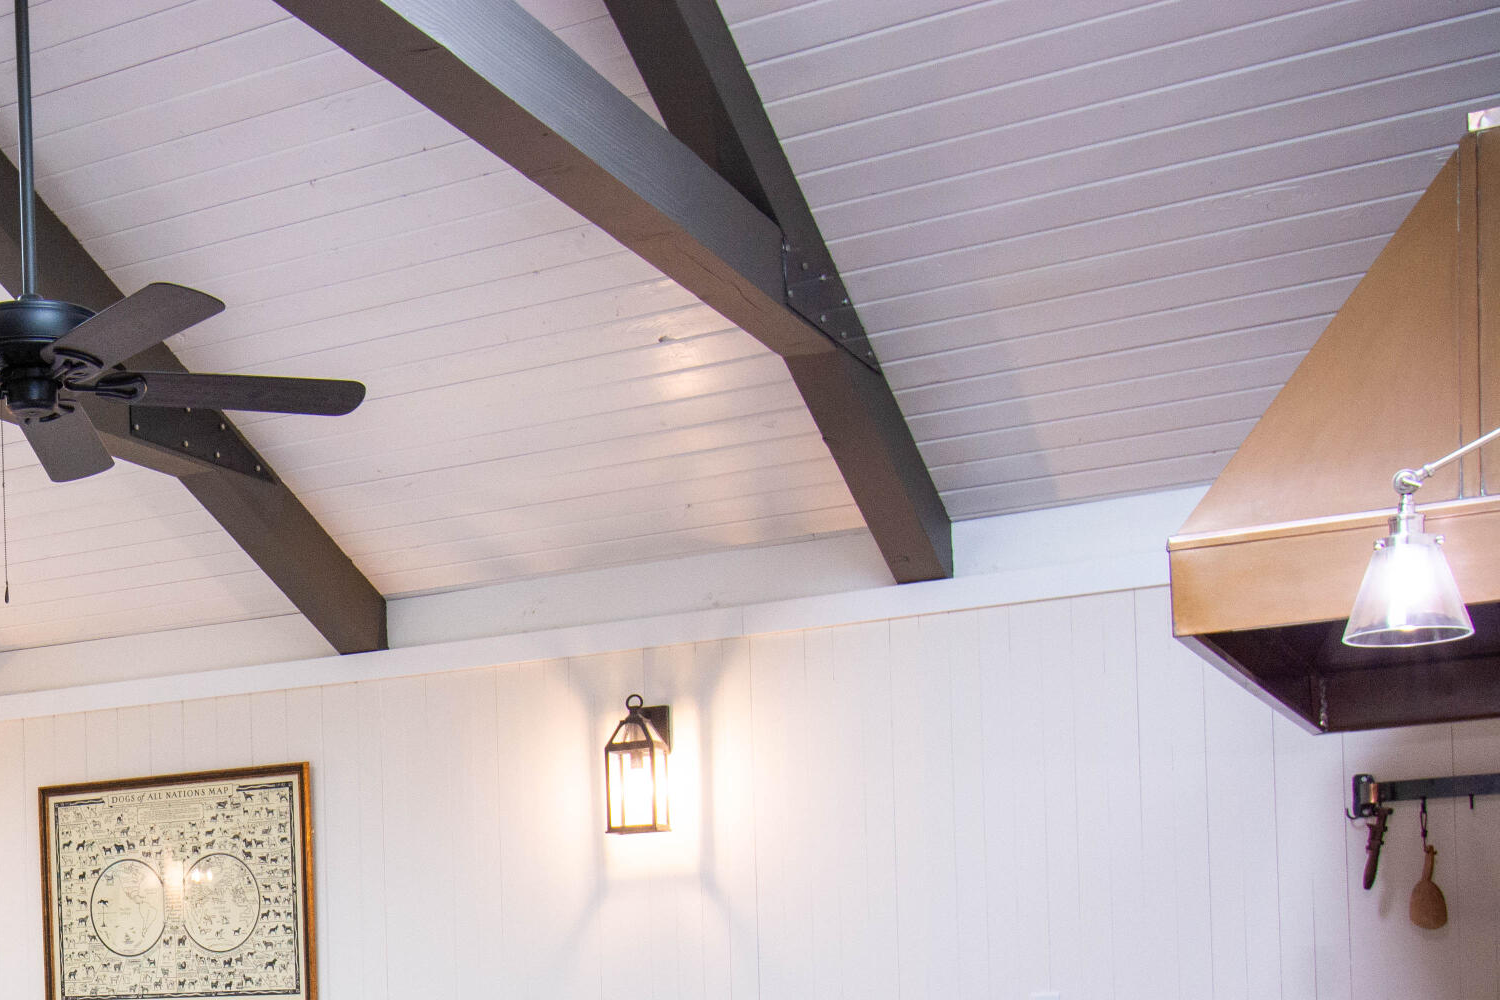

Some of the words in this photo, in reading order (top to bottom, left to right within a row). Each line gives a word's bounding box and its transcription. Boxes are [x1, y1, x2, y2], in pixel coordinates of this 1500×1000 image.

[112, 795, 134, 804] DOGS
[137, 794, 146, 803] of
[166, 789, 206, 800] NATIONS
[208, 787, 228, 796] MAP
